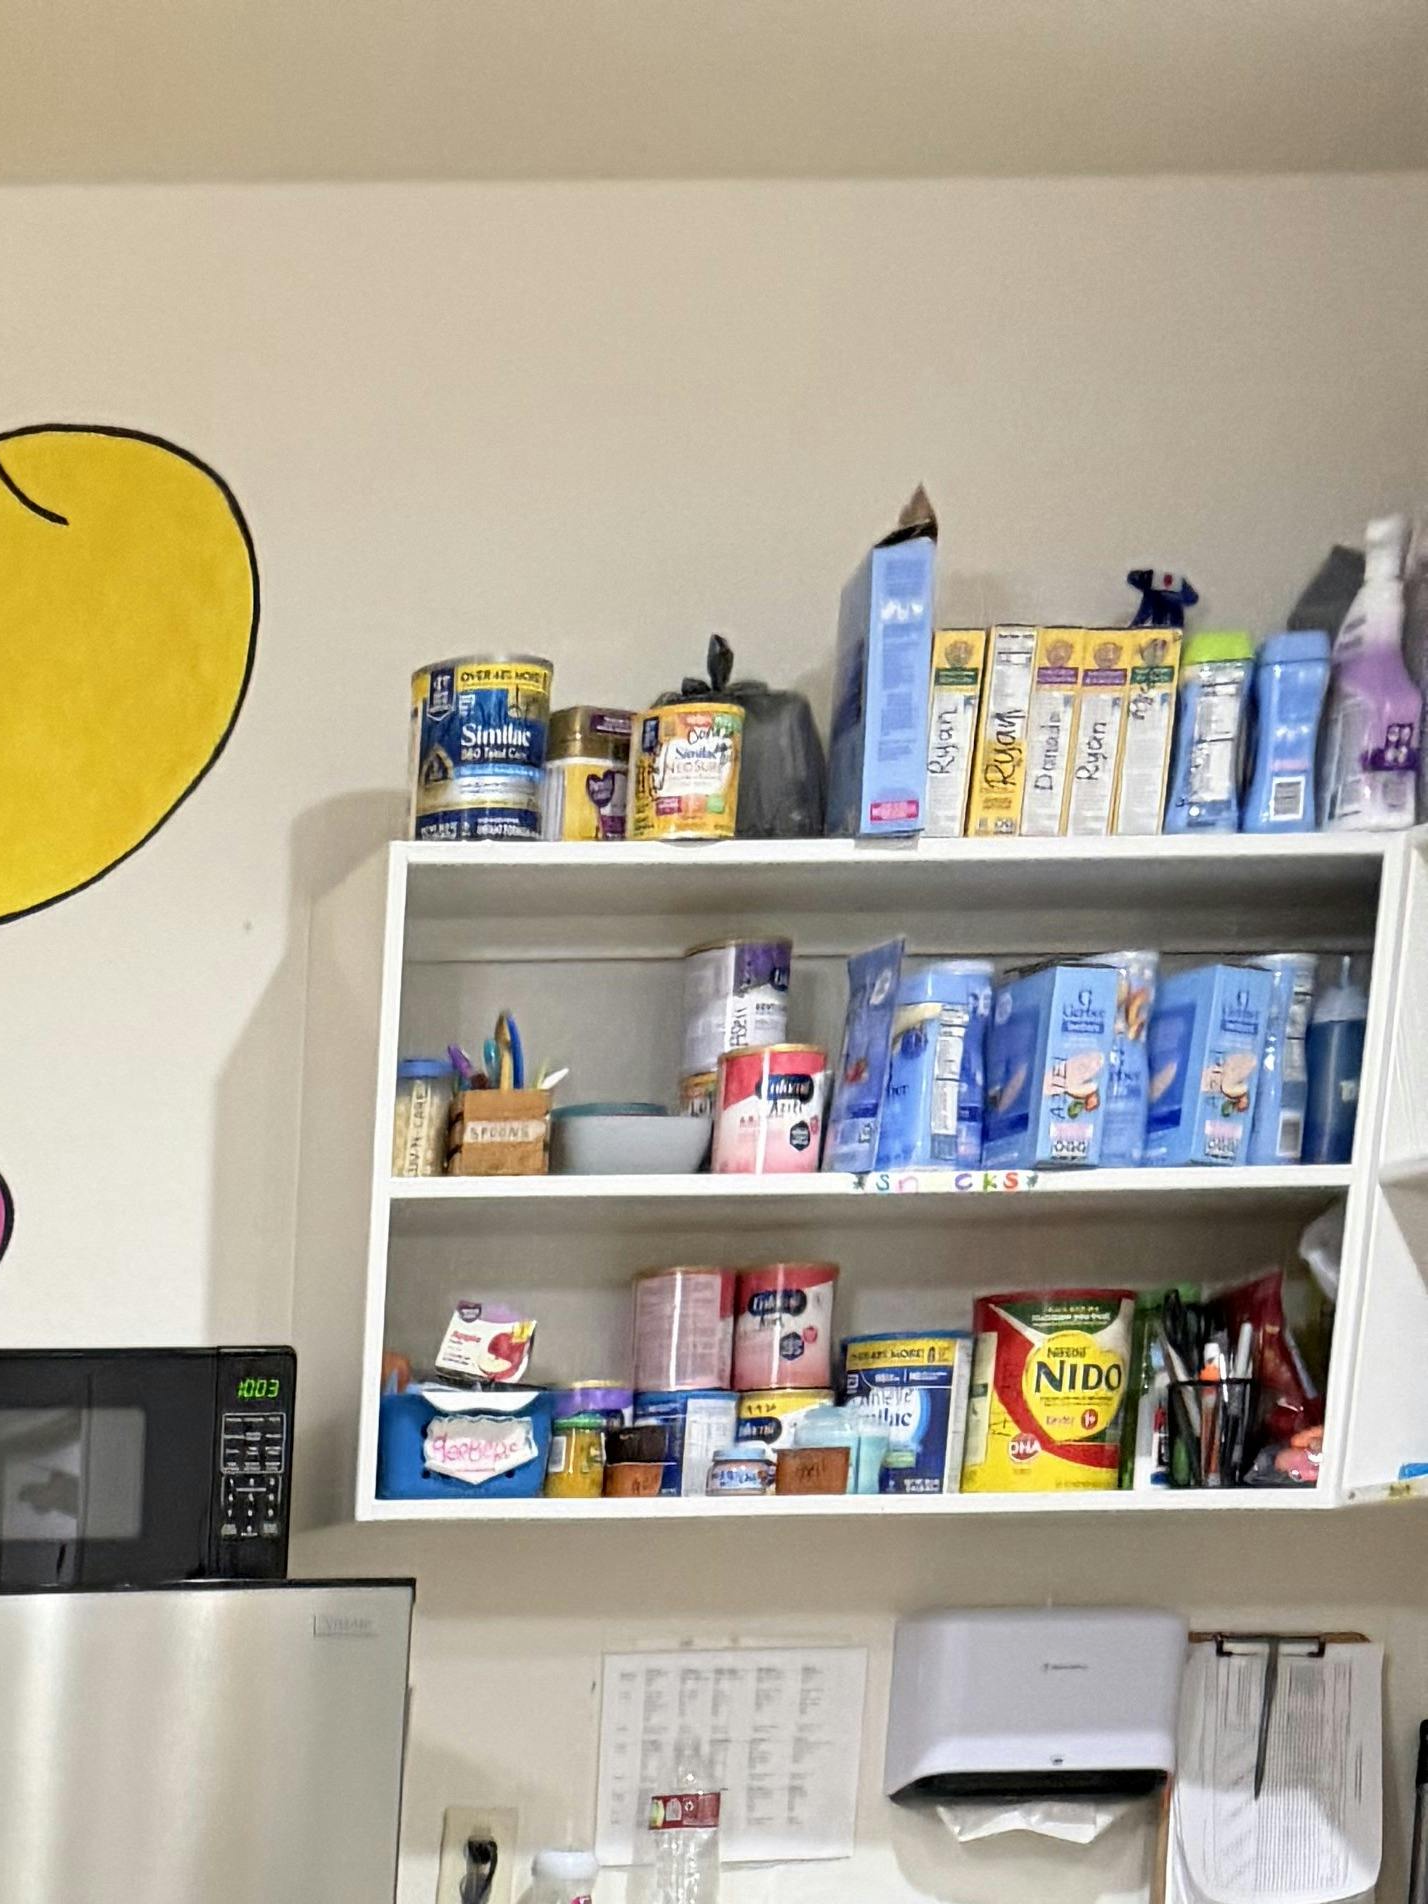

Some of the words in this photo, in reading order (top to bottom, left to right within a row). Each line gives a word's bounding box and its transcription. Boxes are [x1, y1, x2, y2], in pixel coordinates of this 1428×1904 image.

[927, 705, 959, 775] Ryan
[984, 707, 1026, 788] Ryan
[1076, 721, 1107, 781] Ryan
[469, 1124, 530, 1140] SPOONS
[1035, 1360, 1122, 1393] NIDO
[1010, 1441, 1041, 1455] DHA
